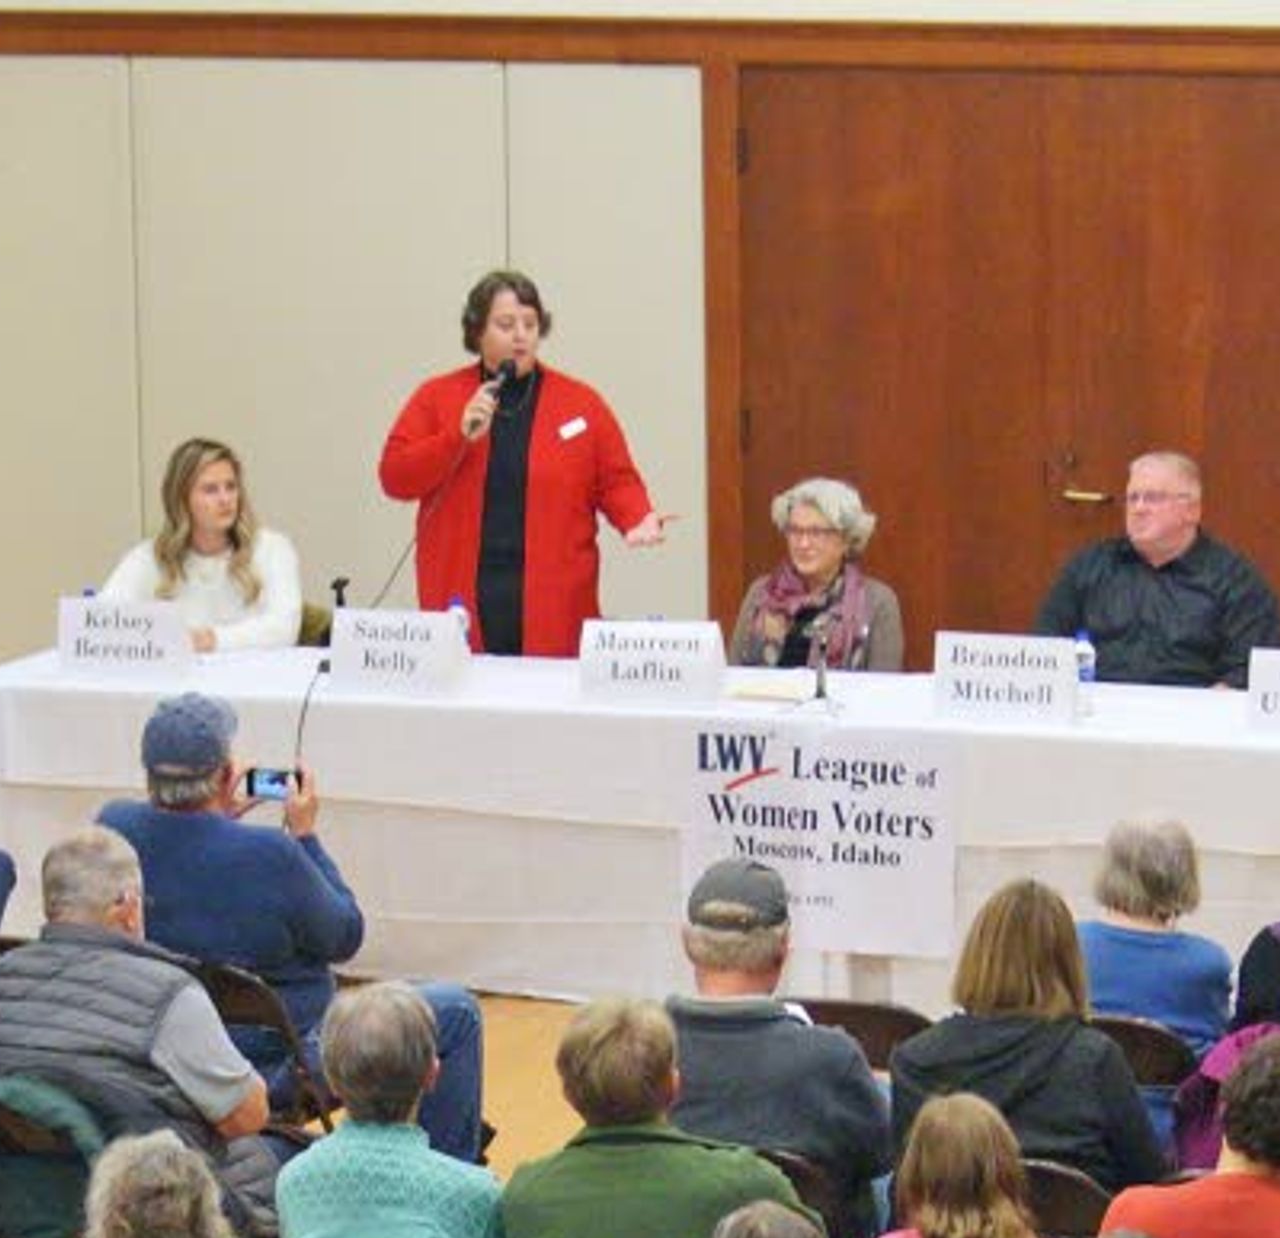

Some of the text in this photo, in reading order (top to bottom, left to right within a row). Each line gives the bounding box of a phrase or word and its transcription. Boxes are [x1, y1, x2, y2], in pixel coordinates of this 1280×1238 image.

[84, 608, 153, 635] Kelsey
[354, 620, 432, 642] Sandra
[595, 630, 701, 652] Maureen
[363, 650, 417, 676] Kelly
[951, 645, 1060, 670] Brandon
[952, 680, 1053, 704] Mitchell
[792, 746, 938, 791] League of
[708, 793, 934, 840] Women Voters
[831, 841, 901, 867] Idaho
